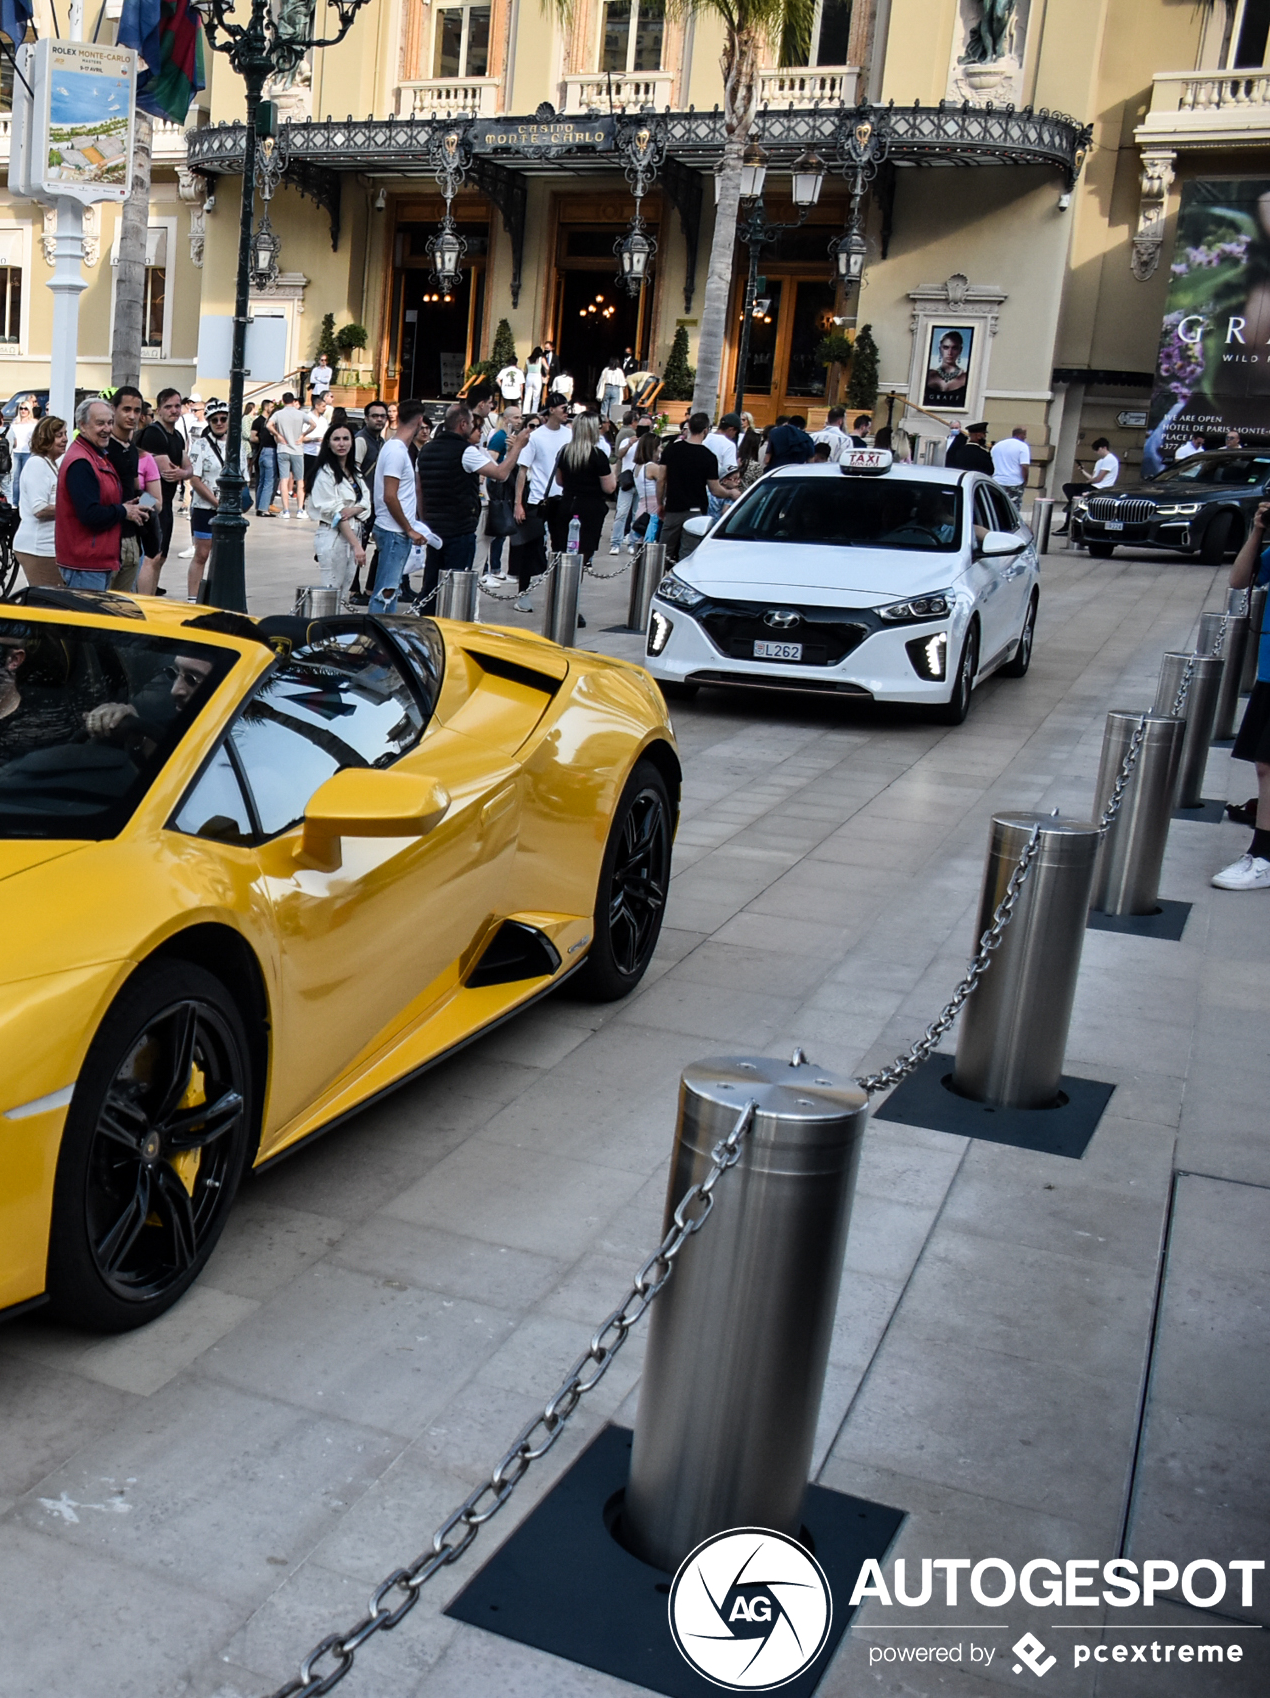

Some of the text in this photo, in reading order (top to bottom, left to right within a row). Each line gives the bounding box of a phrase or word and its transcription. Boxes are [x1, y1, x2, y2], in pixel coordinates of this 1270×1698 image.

[52, 46, 76, 56] ROLEX
[78, 50, 131, 63] MONTE-CARLO
[518, 124, 574, 134] CASINO
[1178, 315, 1270, 344] GR
[1223, 354, 1259, 363] WILD
[1197, 415, 1223, 423] OPEN
[1162, 423, 1192, 431] HÔTEL
[1192, 424, 1205, 432] DE
[1206, 425, 1230, 433] PARIS
[1161, 433, 1186, 441] PLACE
[1160, 442, 1178, 450] +377
[850, 454, 880, 464] TAXI
[766, 644, 799, 658] L262
